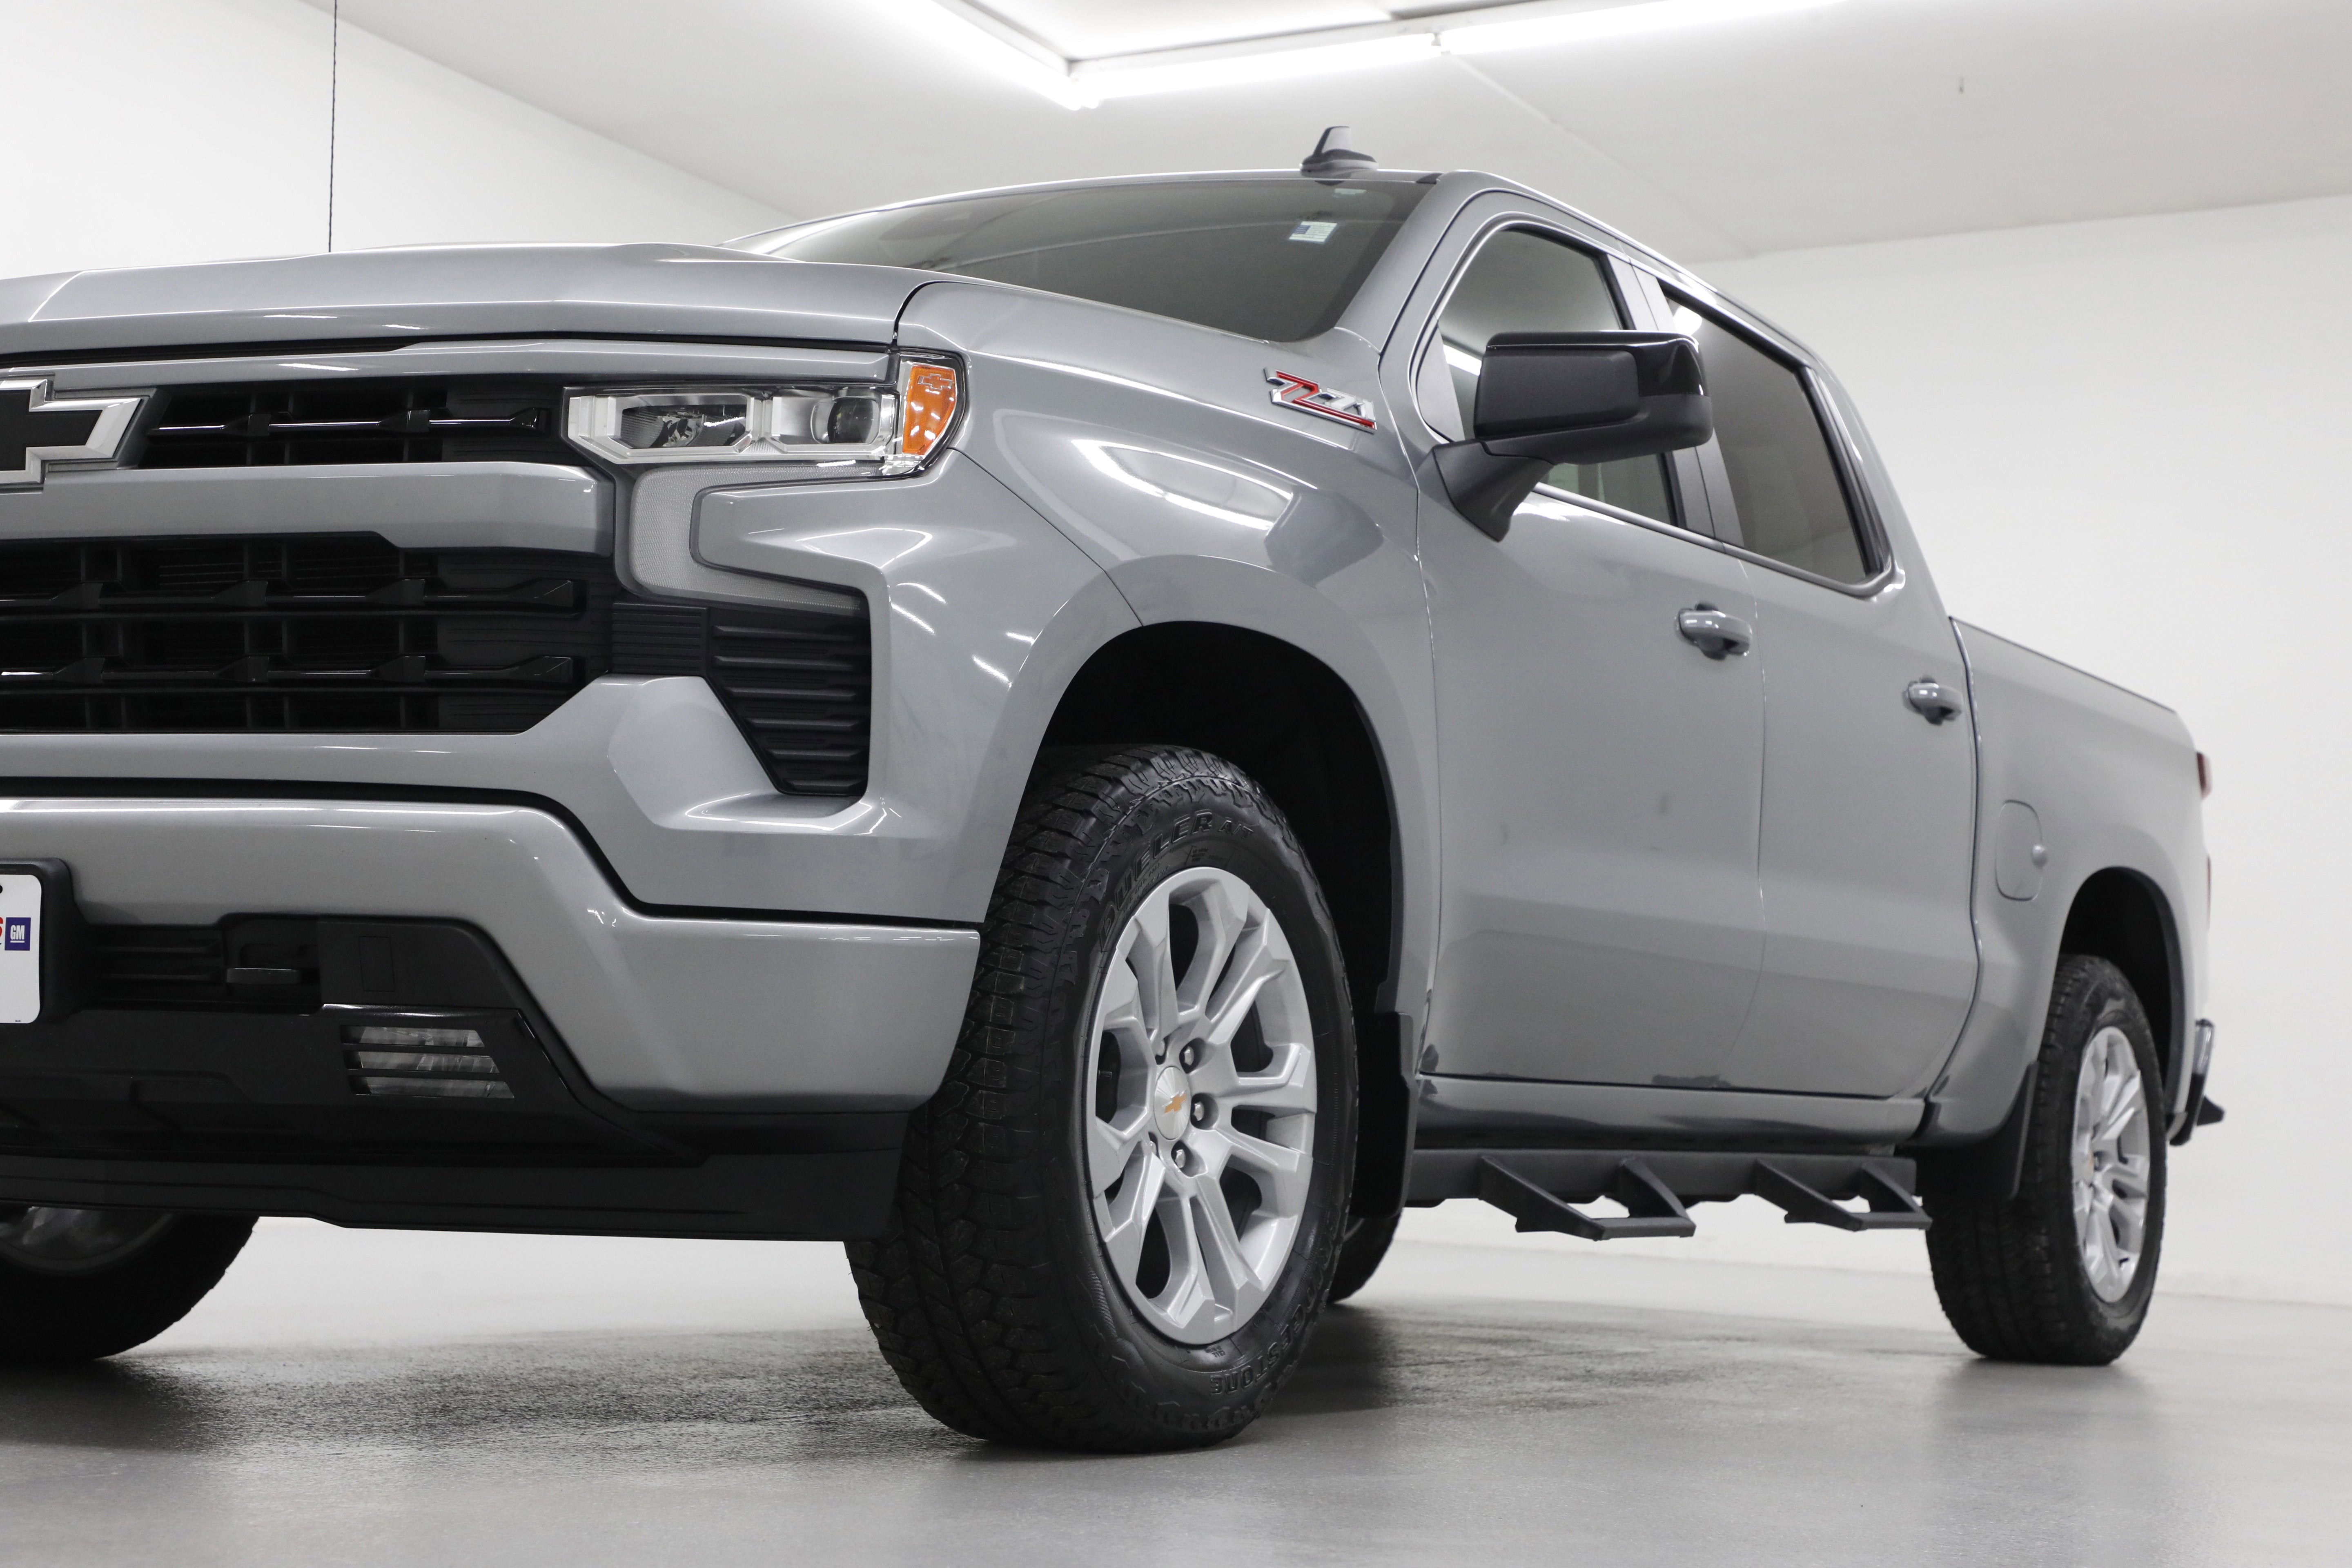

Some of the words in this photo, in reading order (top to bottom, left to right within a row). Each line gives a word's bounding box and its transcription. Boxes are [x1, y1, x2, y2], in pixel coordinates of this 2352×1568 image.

[1263, 367, 1377, 431] Z71
[1098, 809, 1213, 953] DUELER
[1218, 817, 1254, 839] A/T
[10, 924, 25, 940] GM
